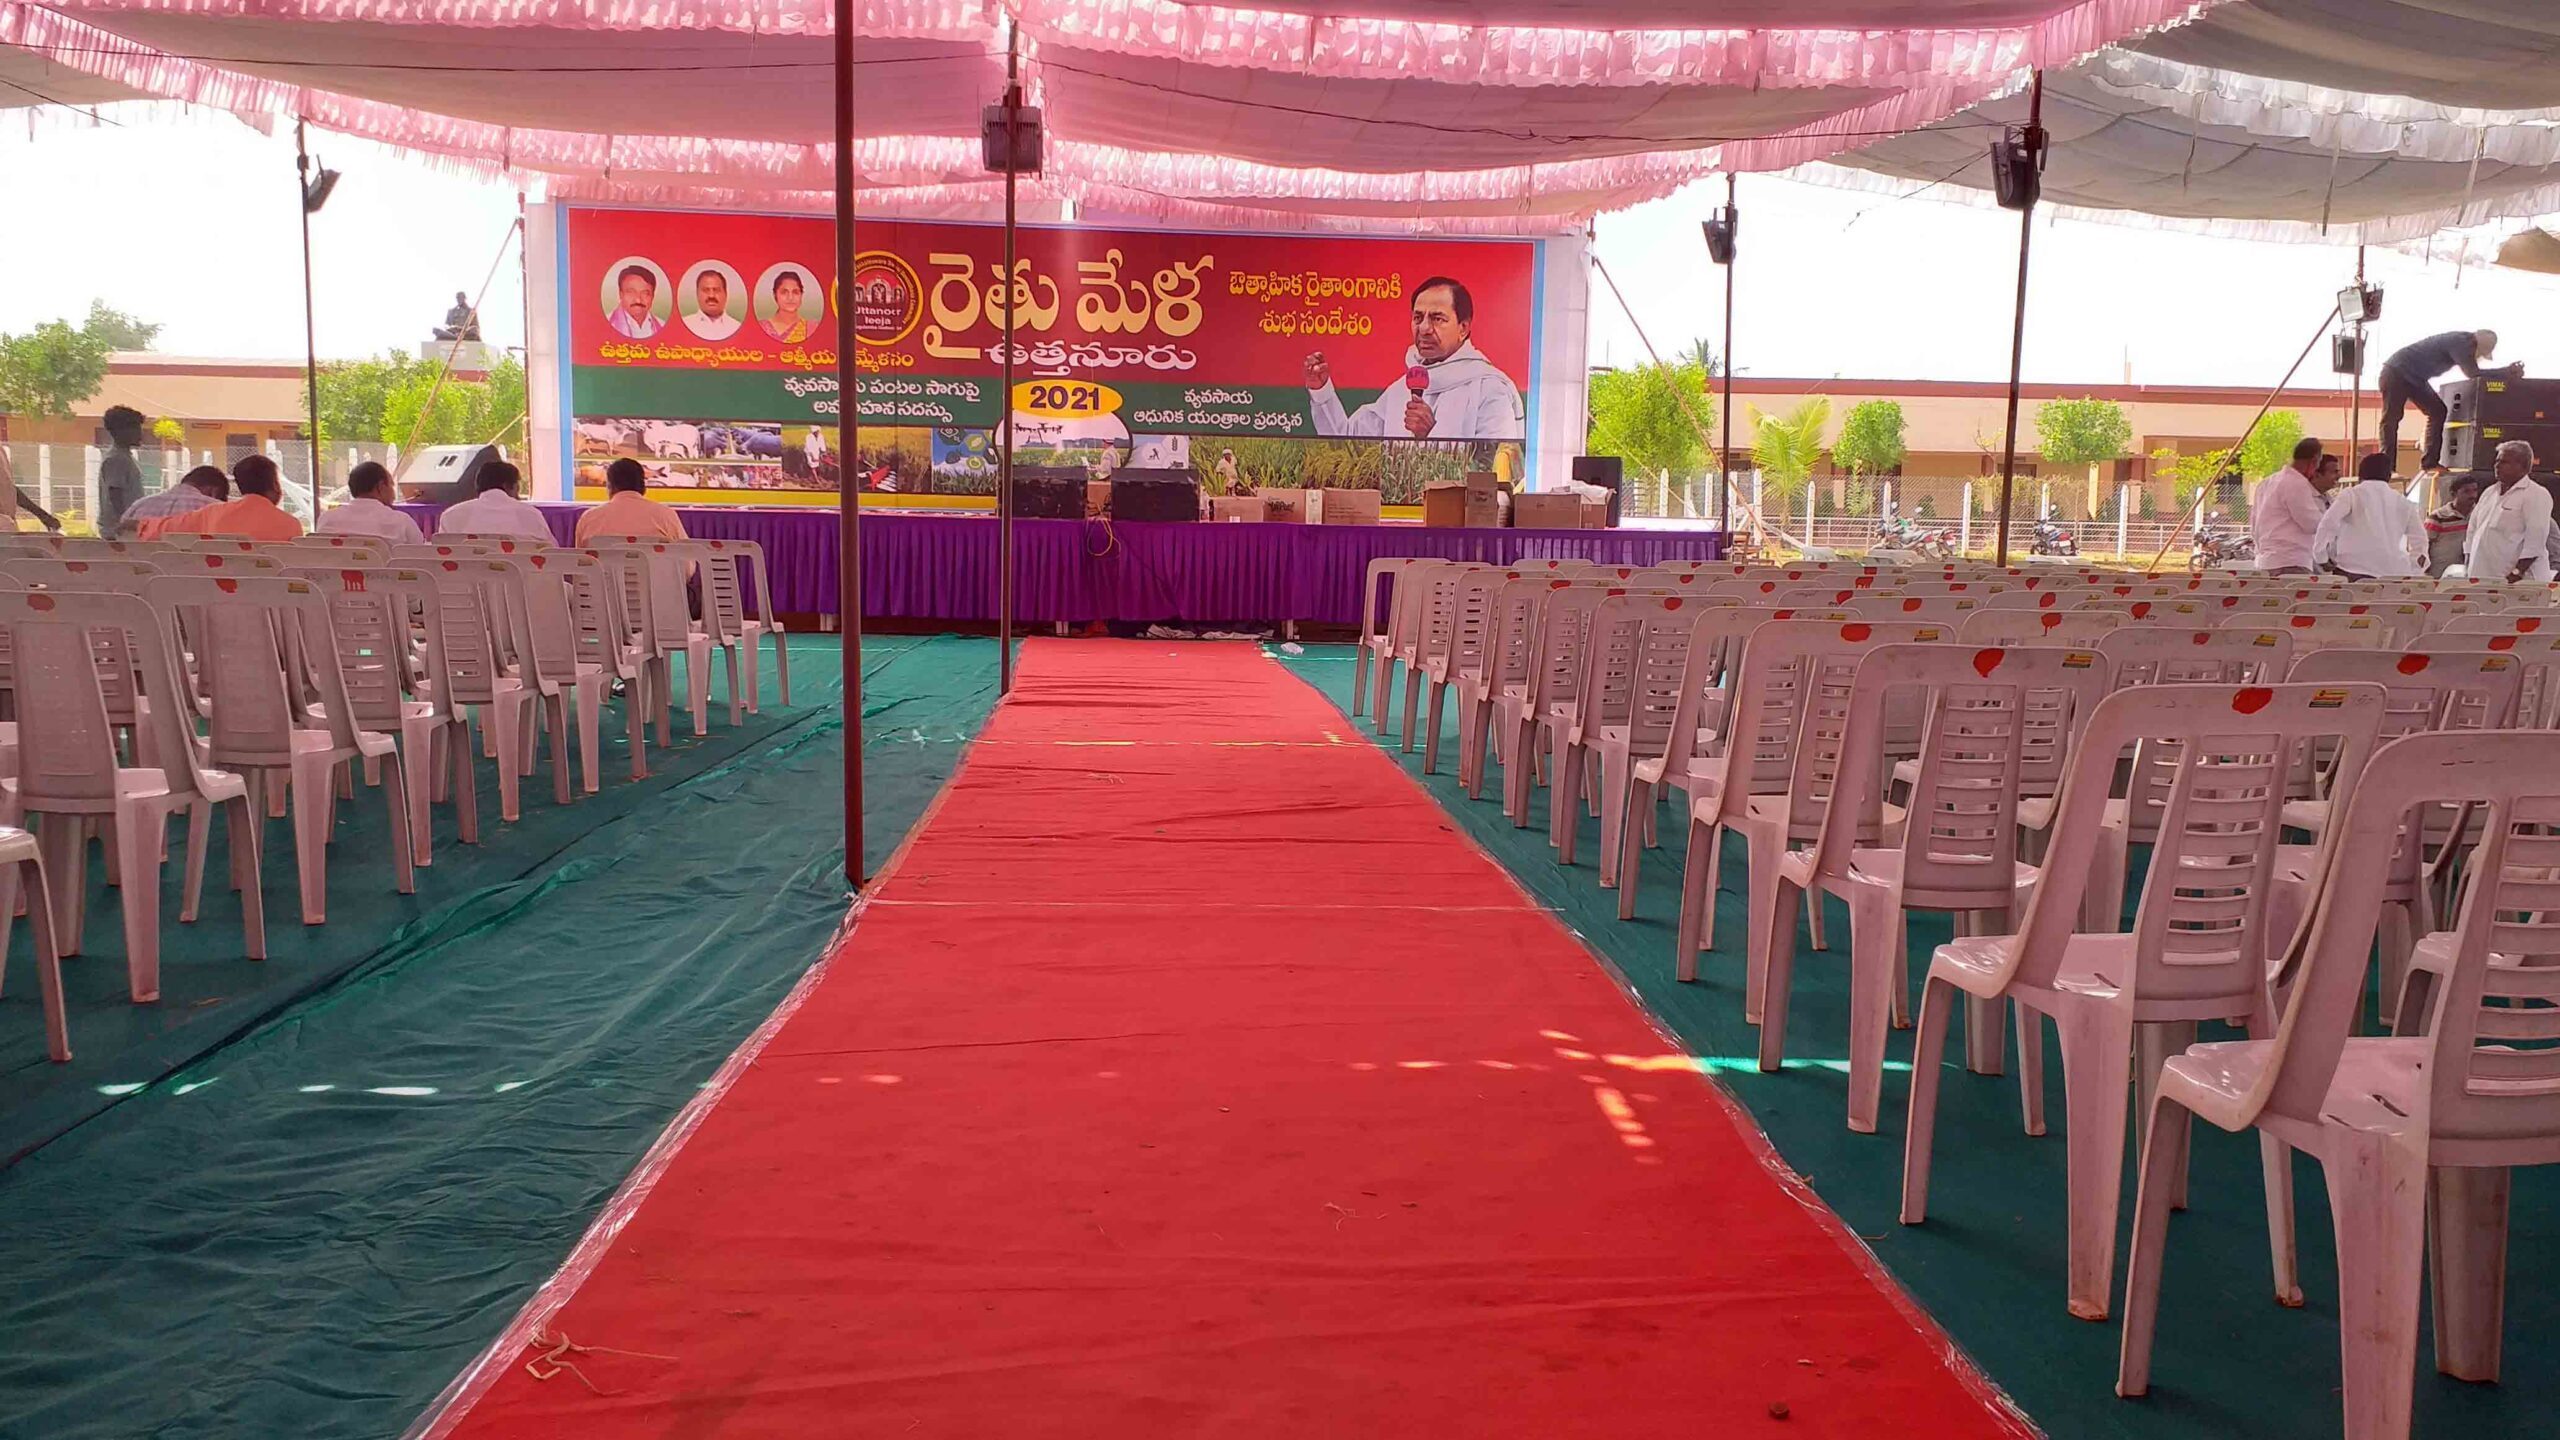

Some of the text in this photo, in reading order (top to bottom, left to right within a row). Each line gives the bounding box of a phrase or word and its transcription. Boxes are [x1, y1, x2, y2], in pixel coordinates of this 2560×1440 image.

[923, 252, 1060, 359] రైతు
[1076, 249, 1214, 337] మేళ
[1258, 306, 1373, 338] శుభ సందేశం
[599, 341, 651, 364] ఉత్తమ
[984, 337, 1197, 377] ఉత్తనూరు
[869, 378, 922, 395] పంటల
[1029, 385, 1100, 410] 2021
[1184, 388, 1253, 409] వ్యవసాయ
